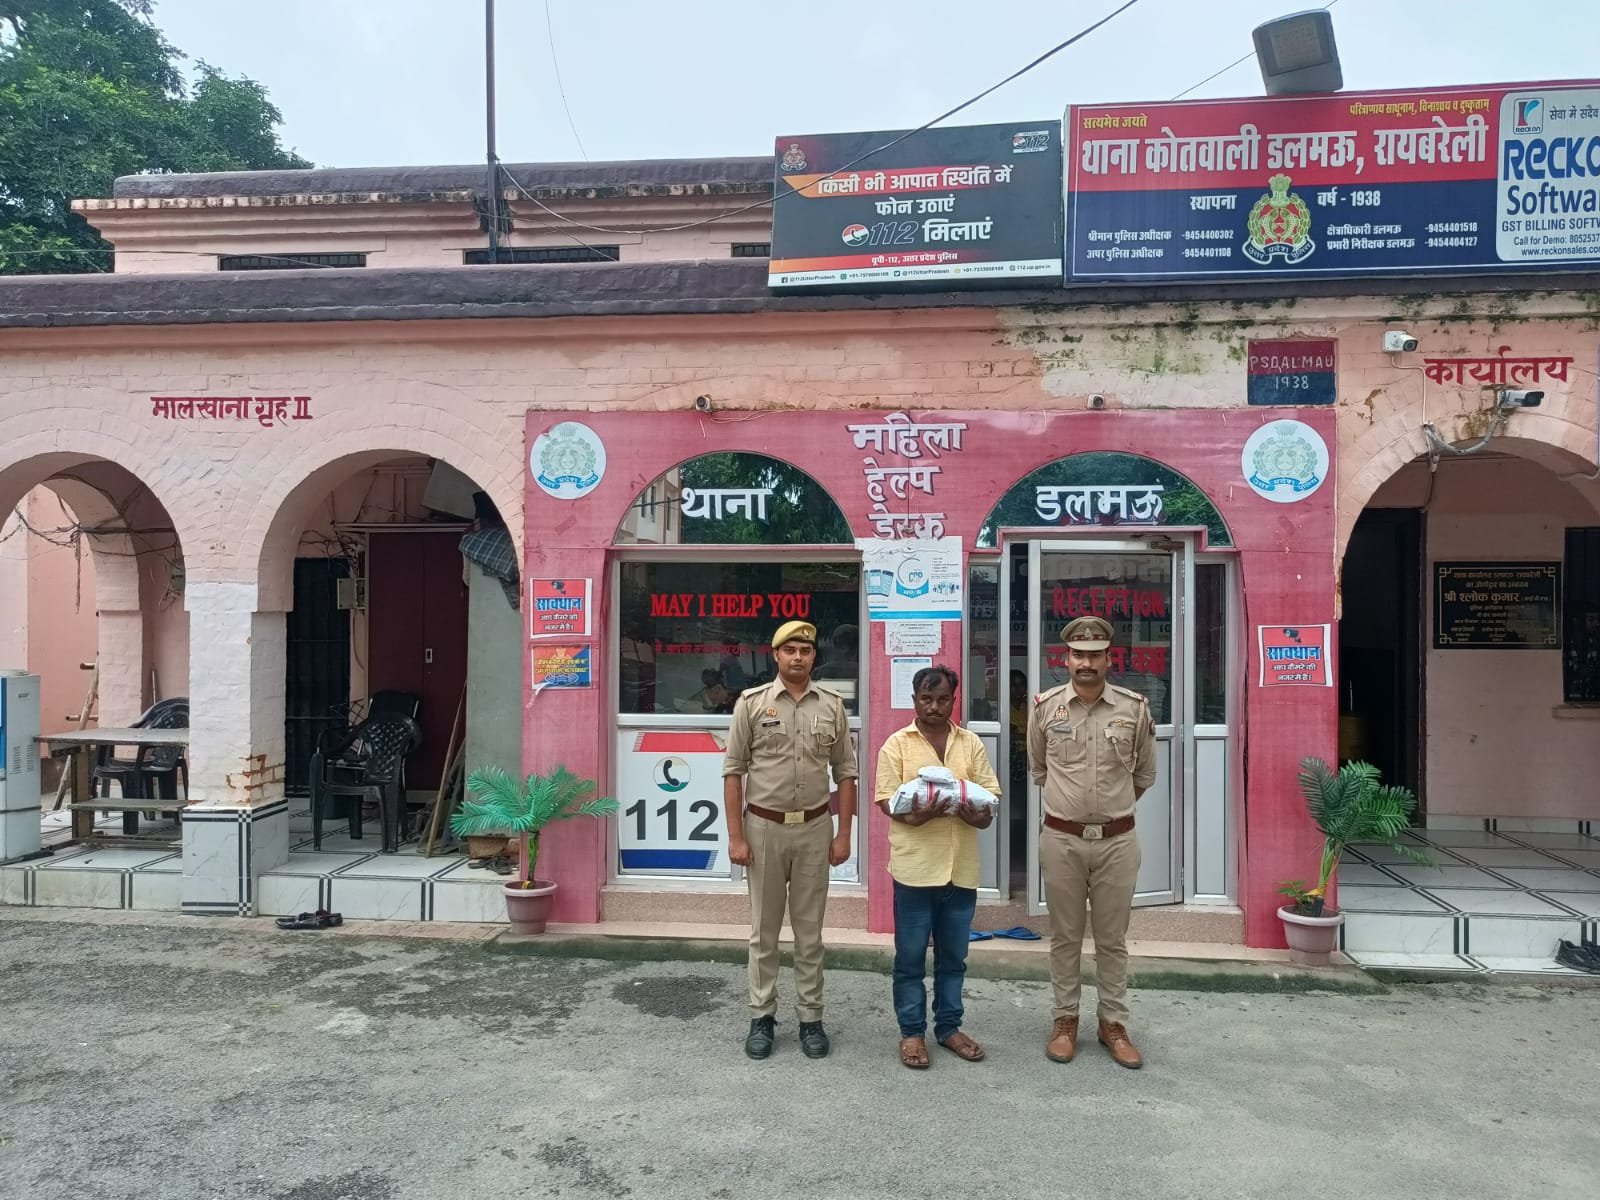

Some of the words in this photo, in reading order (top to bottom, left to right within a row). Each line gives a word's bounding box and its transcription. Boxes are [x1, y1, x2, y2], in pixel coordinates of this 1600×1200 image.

[1452, 101, 1458, 111] च
[1549, 106, 1566, 120] सेवा
[1568, 105, 1577, 118] में
[1580, 104, 1599, 118] सदैव
[1083, 116, 1120, 129] सत्यमेव
[1122, 113, 1148, 128] जयते
[1081, 139, 1140, 175] थाना
[1144, 124, 1261, 172] कोतवाली
[1267, 131, 1365, 174] डलमऊ,
[1373, 114, 1489, 165] रायबरेली
[817, 173, 860, 195] किसी
[864, 172, 886, 191] भी
[890, 173, 938, 189] आपात
[942, 167, 991, 187] स्थिति
[994, 165, 1014, 183] में
[875, 197, 913, 215] फोन
[916, 194, 955, 213] उठाएं
[1190, 195, 1236, 211] स्थापना
[1318, 187, 1337, 207] वर्ष
[1351, 190, 1381, 206] 1938
[1506, 181, 1600, 216] Softwa
[869, 220, 918, 245] 112
[922, 216, 993, 242] मिलाएं
[1088, 230, 1112, 241] श्रीमान
[1115, 229, 1137, 244] पुलिस
[1139, 229, 1172, 241] अधीक्षक
[1327, 223, 1371, 236] क्षेत्राधिकारी
[1373, 224, 1401, 235] डलमऊ
[1502, 220, 1522, 233] GST
[1525, 219, 1565, 231] BILLING
[1327, 238, 1349, 250] प्रभारी
[1351, 237, 1385, 249] निरीक्षक
[1386, 238, 1415, 249] डलमऊ
[1513, 236, 1529, 246] Call
[1530, 235, 1541, 245] for
[1543, 234, 1568, 245] Demo:
[1521, 244, 1600, 256] www.reckonsales.co
[1087, 249, 1104, 259] अपर
[1107, 247, 1129, 261] पुलिस
[1131, 246, 1164, 258] अधीक्षक
[1423, 346, 1574, 385] कार्यालय
[1275, 375, 1309, 389] 1938
[150, 396, 253, 419] मालखाना
[255, 396, 291, 427] गृह
[846, 412, 969, 458] महिला
[863, 457, 943, 502] हेल्प
[680, 488, 773, 521] थाना
[1035, 485, 1164, 520] डलमऊ
[536, 597, 582, 611] सावधान
[650, 594, 693, 617] MAY
[698, 594, 706, 617] I
[711, 594, 764, 618] HELP
[768, 594, 811, 618] YOU
[1053, 586, 1166, 619] RECEPTION
[1443, 590, 1457, 602] श्री
[1491, 592, 1521, 604] कुमार
[1266, 646, 1321, 660] सावधान
[625, 799, 719, 842] 112
